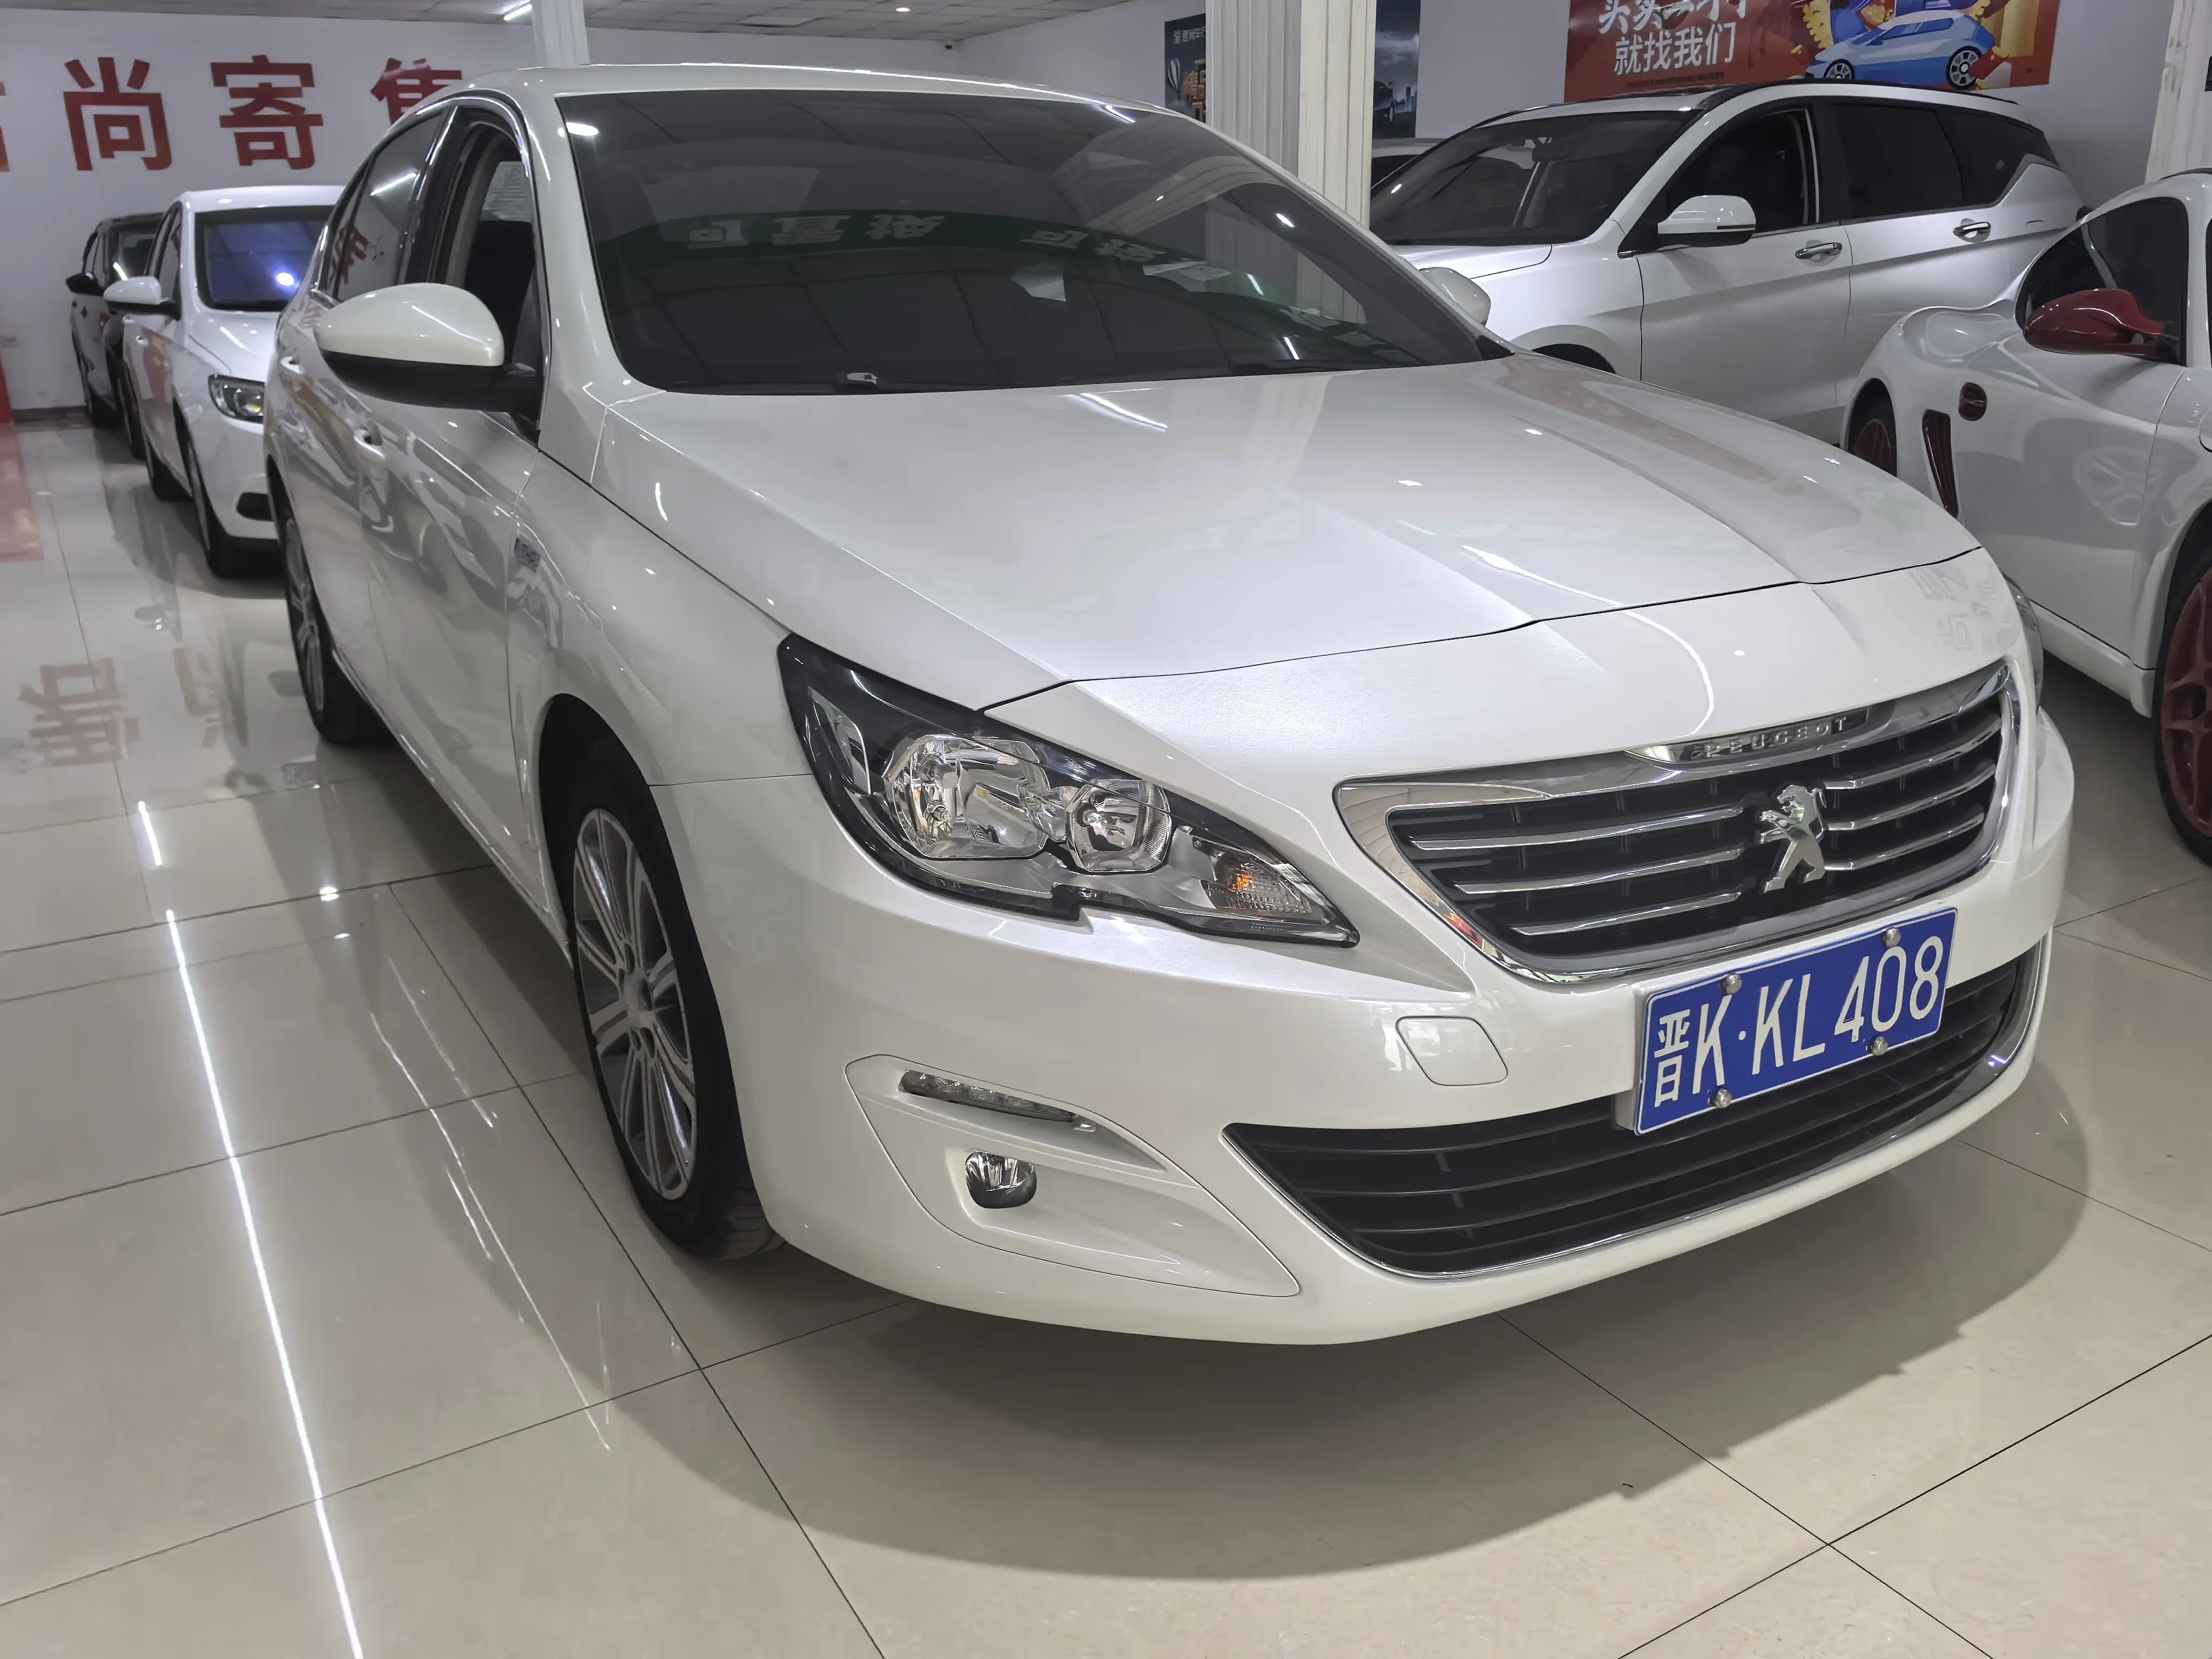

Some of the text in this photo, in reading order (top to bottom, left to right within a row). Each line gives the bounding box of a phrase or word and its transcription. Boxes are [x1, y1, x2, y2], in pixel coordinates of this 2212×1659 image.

[1613, 22, 1737, 76] 就找我们
[0, 55, 462, 171] 尚寄
[1704, 716, 1847, 758] PEUGEOT
[1654, 936, 1944, 1108] 晋K·KL408
